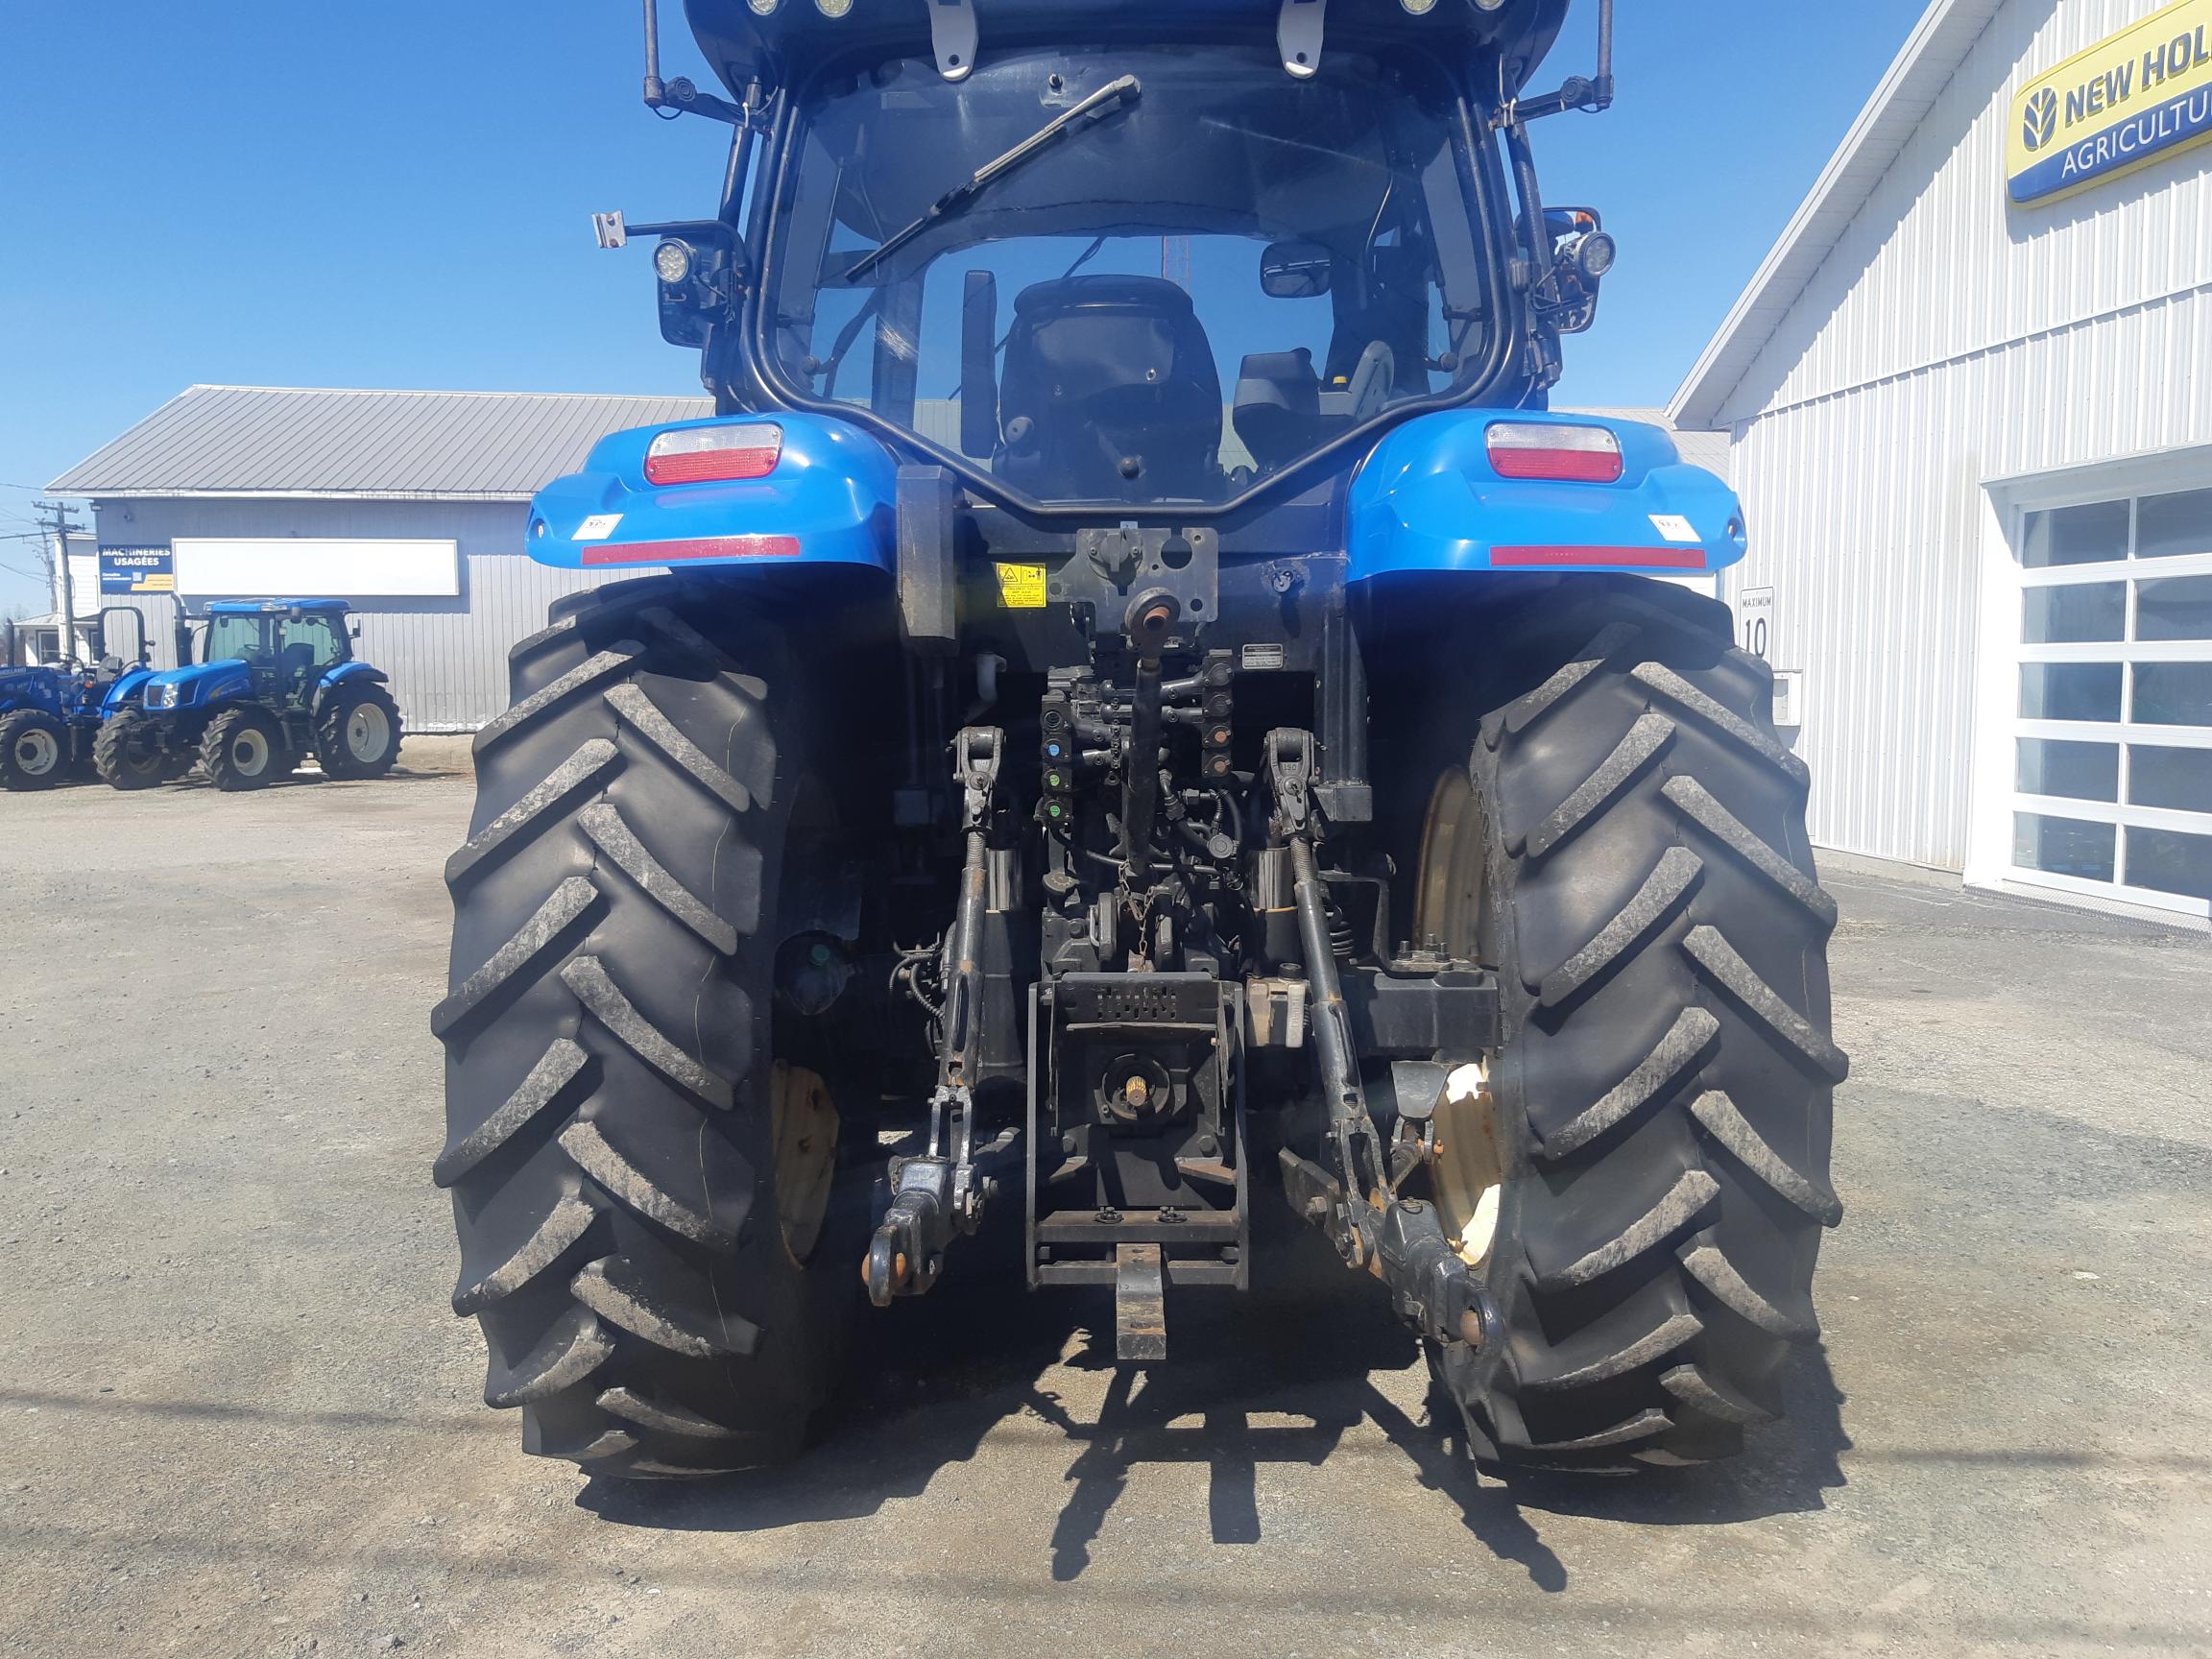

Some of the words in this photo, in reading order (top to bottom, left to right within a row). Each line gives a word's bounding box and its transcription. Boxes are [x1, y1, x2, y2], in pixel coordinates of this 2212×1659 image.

[2064, 59, 2134, 128] NEW
[2141, 23, 2212, 91] HOL
[2061, 89, 2212, 179] AGRICULTU
[102, 548, 171, 557] MACHINERIES
[114, 556, 159, 566] USAGÉES
[1742, 596, 1771, 609] MAXIMUM
[1745, 616, 1767, 660] 10
